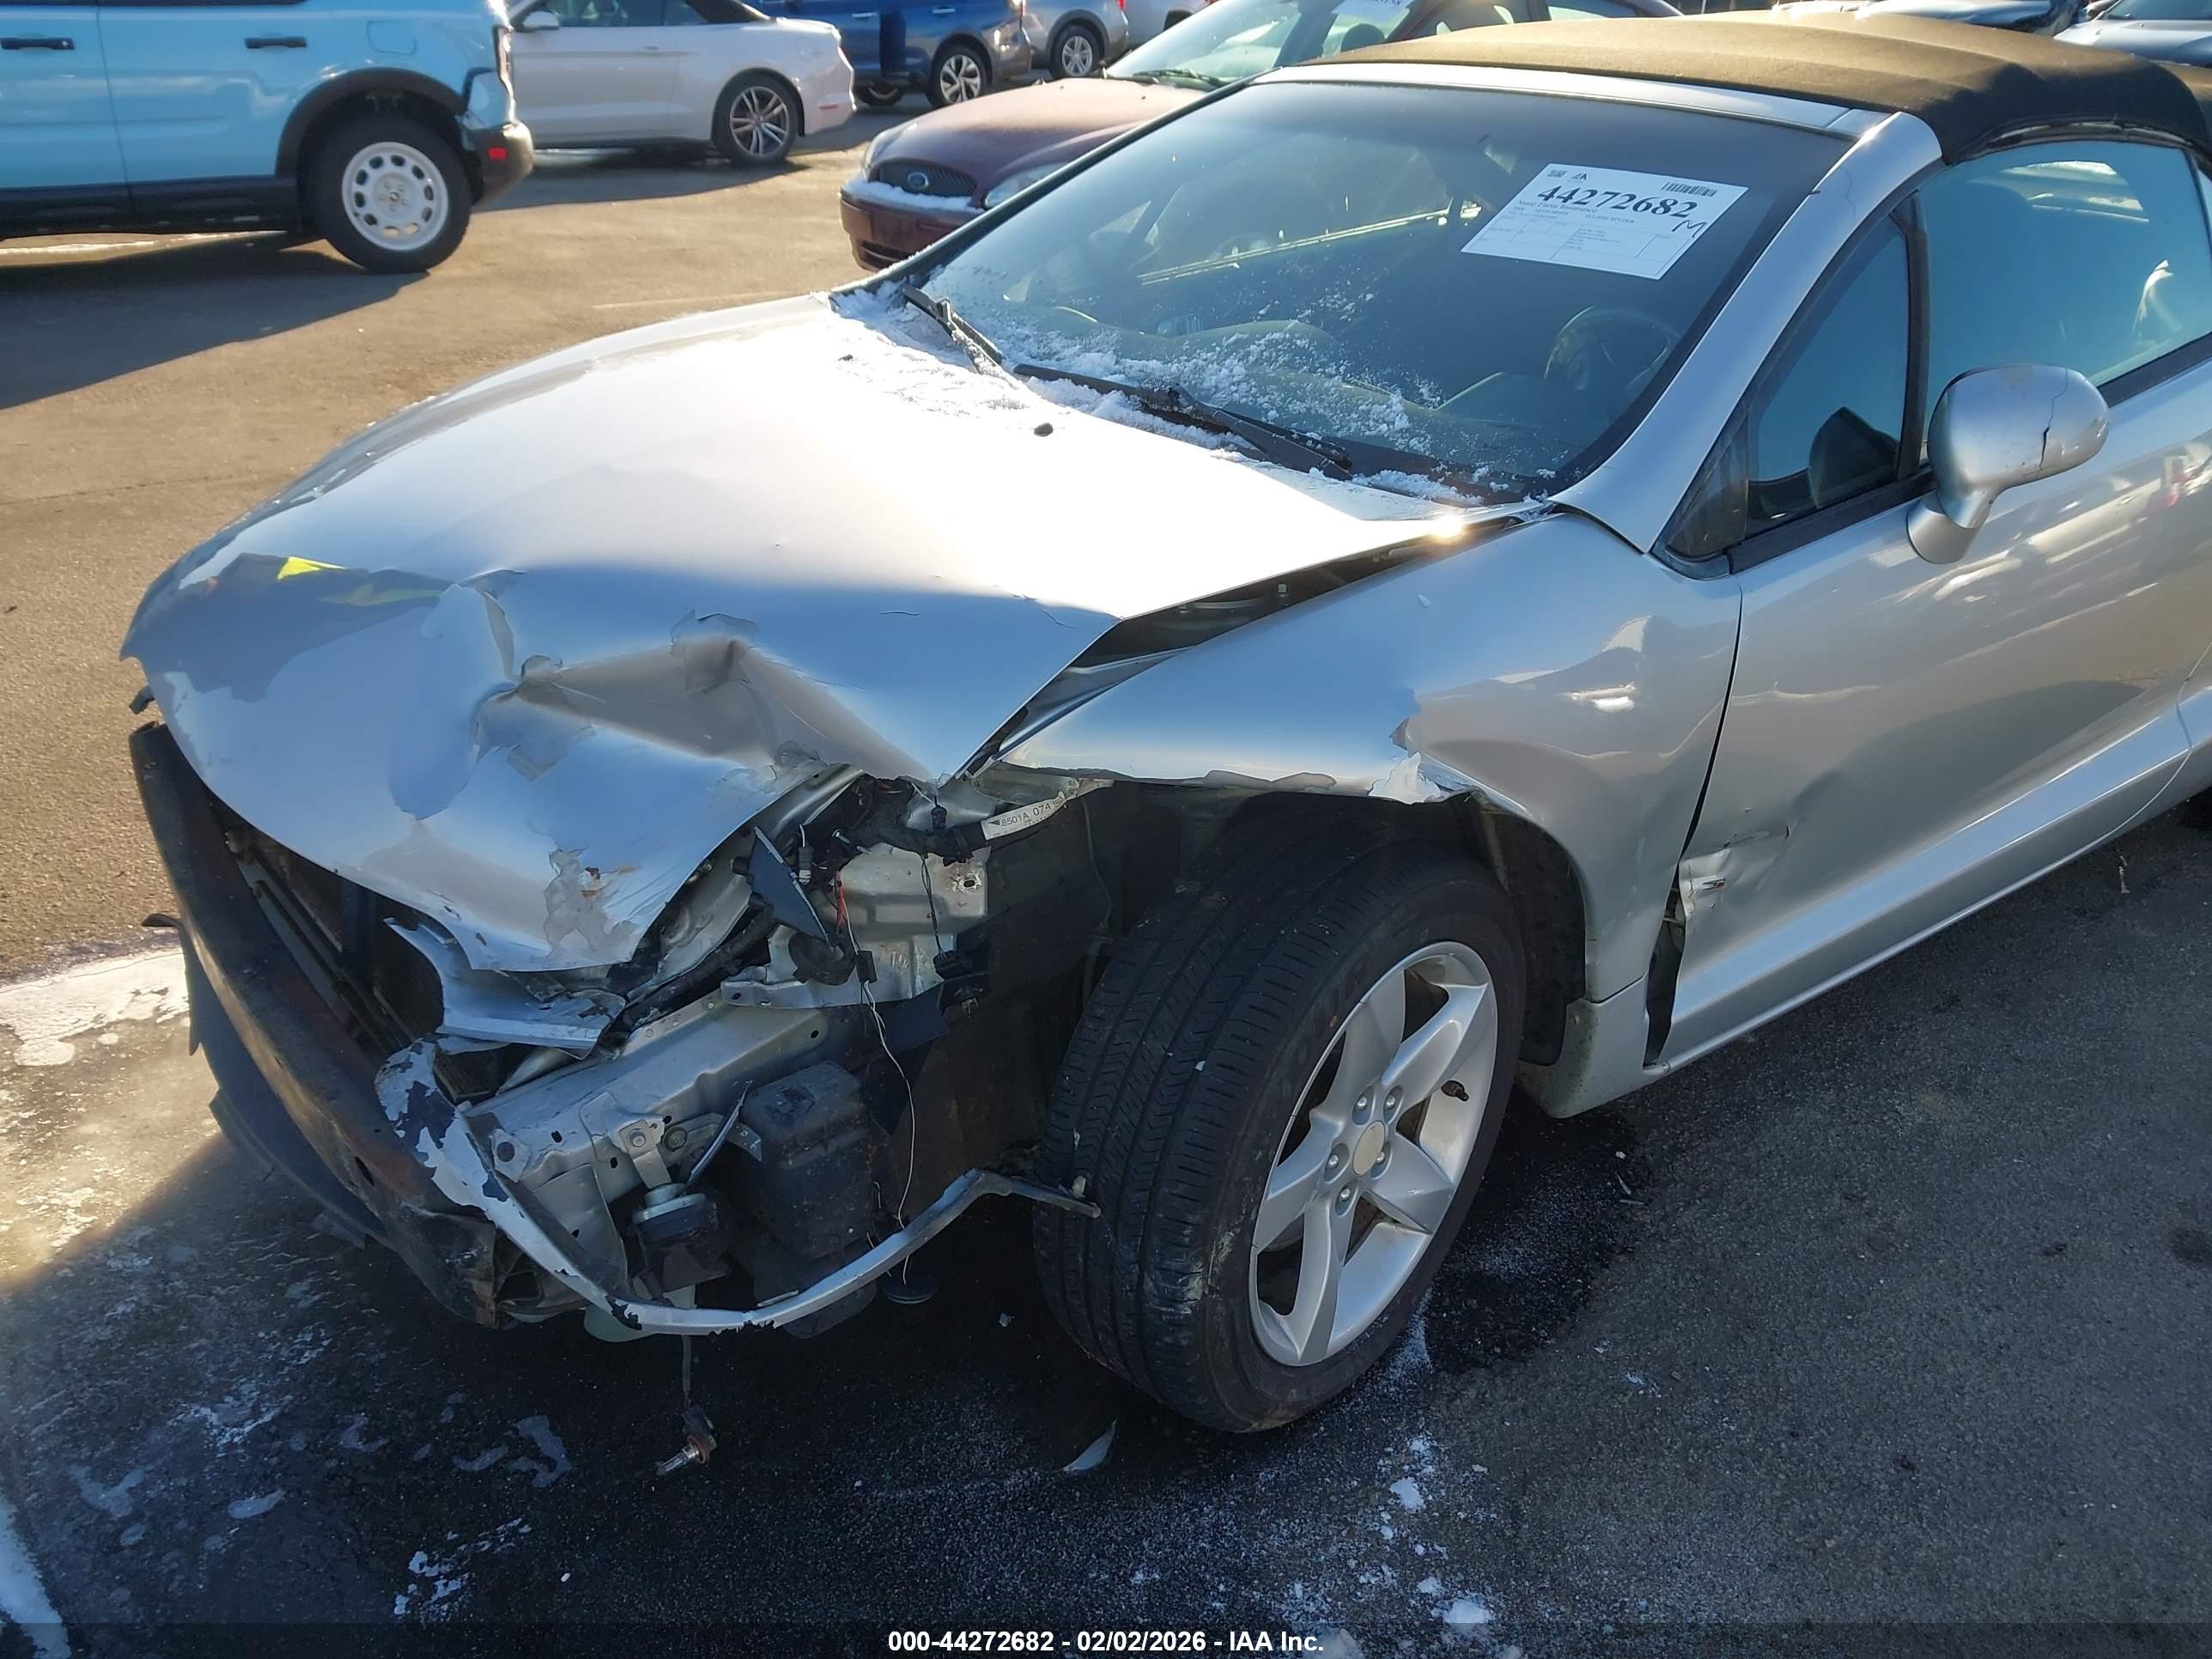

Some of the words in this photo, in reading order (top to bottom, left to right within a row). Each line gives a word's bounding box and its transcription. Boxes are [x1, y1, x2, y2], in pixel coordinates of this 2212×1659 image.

[1537, 185, 1698, 218] 44272682
[1671, 219, 1708, 239] M
[1001, 811, 1030, 827] 8501A
[1032, 802, 1052, 817] 074
